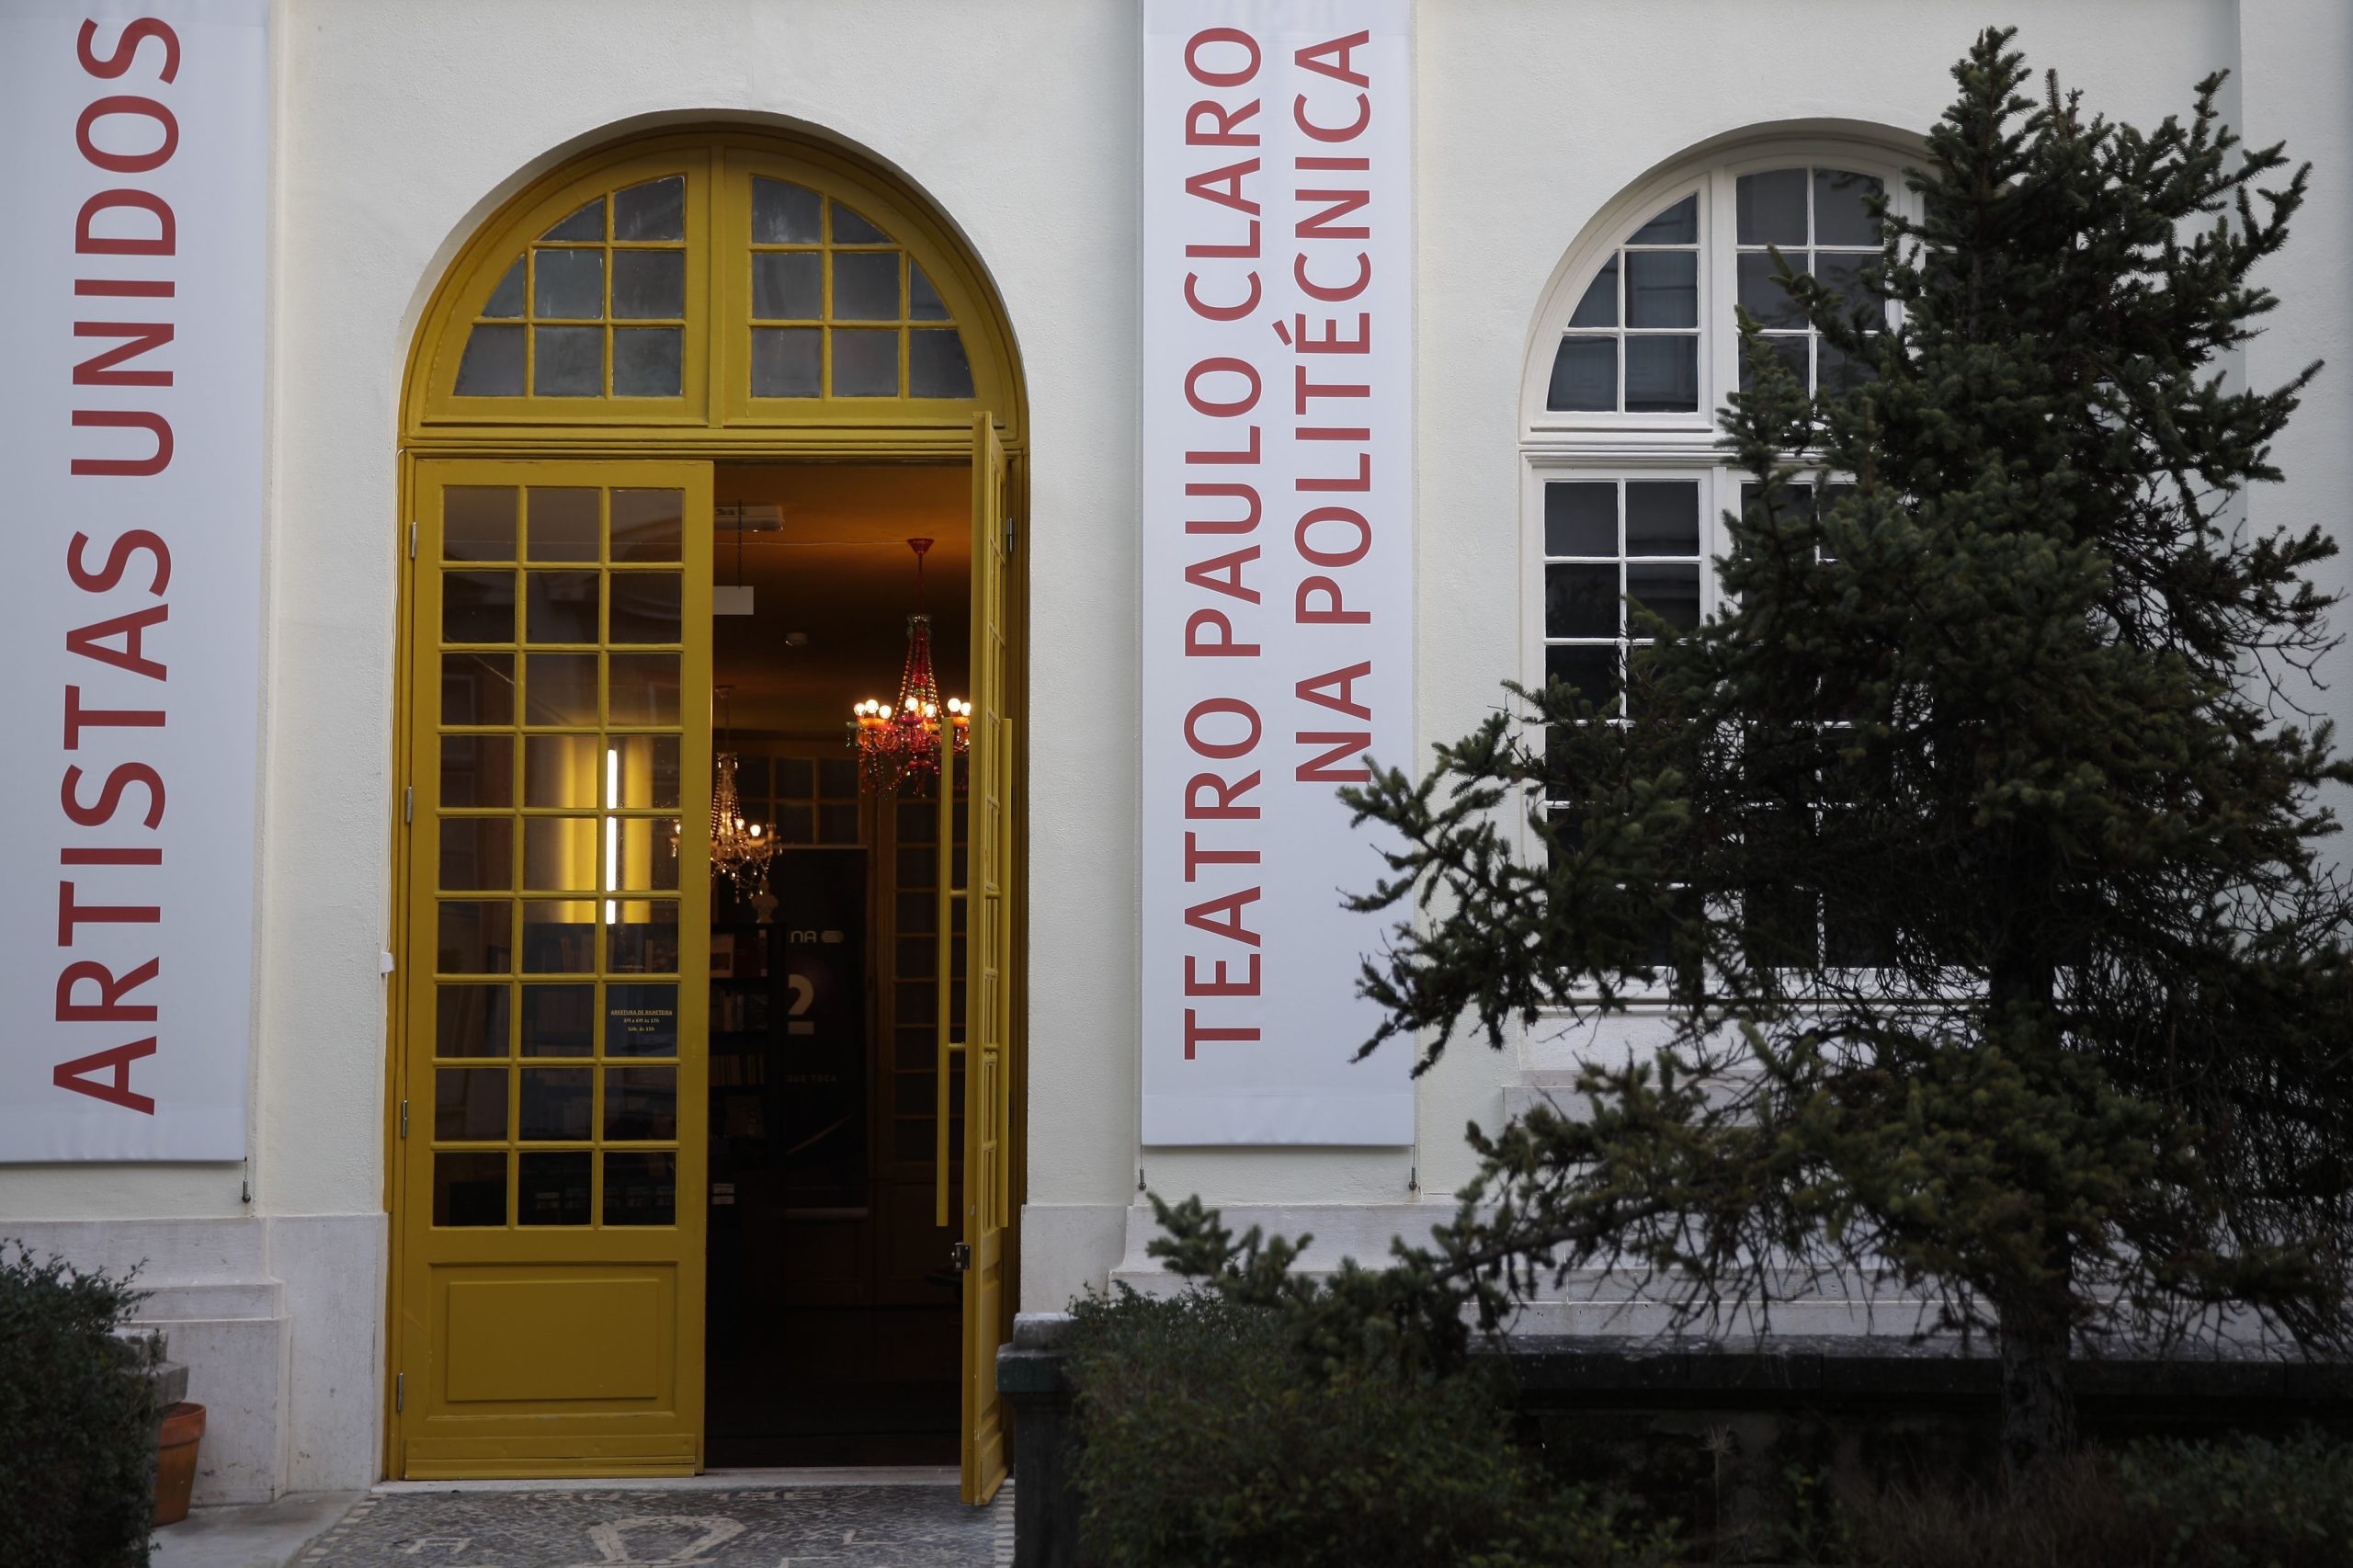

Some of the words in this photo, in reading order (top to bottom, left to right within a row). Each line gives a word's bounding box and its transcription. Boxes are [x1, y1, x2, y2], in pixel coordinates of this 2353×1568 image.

[72, 17, 181, 477] UNIDOS
[1185, 28, 1261, 321] CLARO
[1272, 31, 1371, 624] POLITÉCNICA
[1185, 358, 1261, 657] PAULO
[54, 529, 172, 1114] ARTISTAS
[1185, 698, 1261, 1060] TEATRO
[1295, 662, 1371, 782] NA
